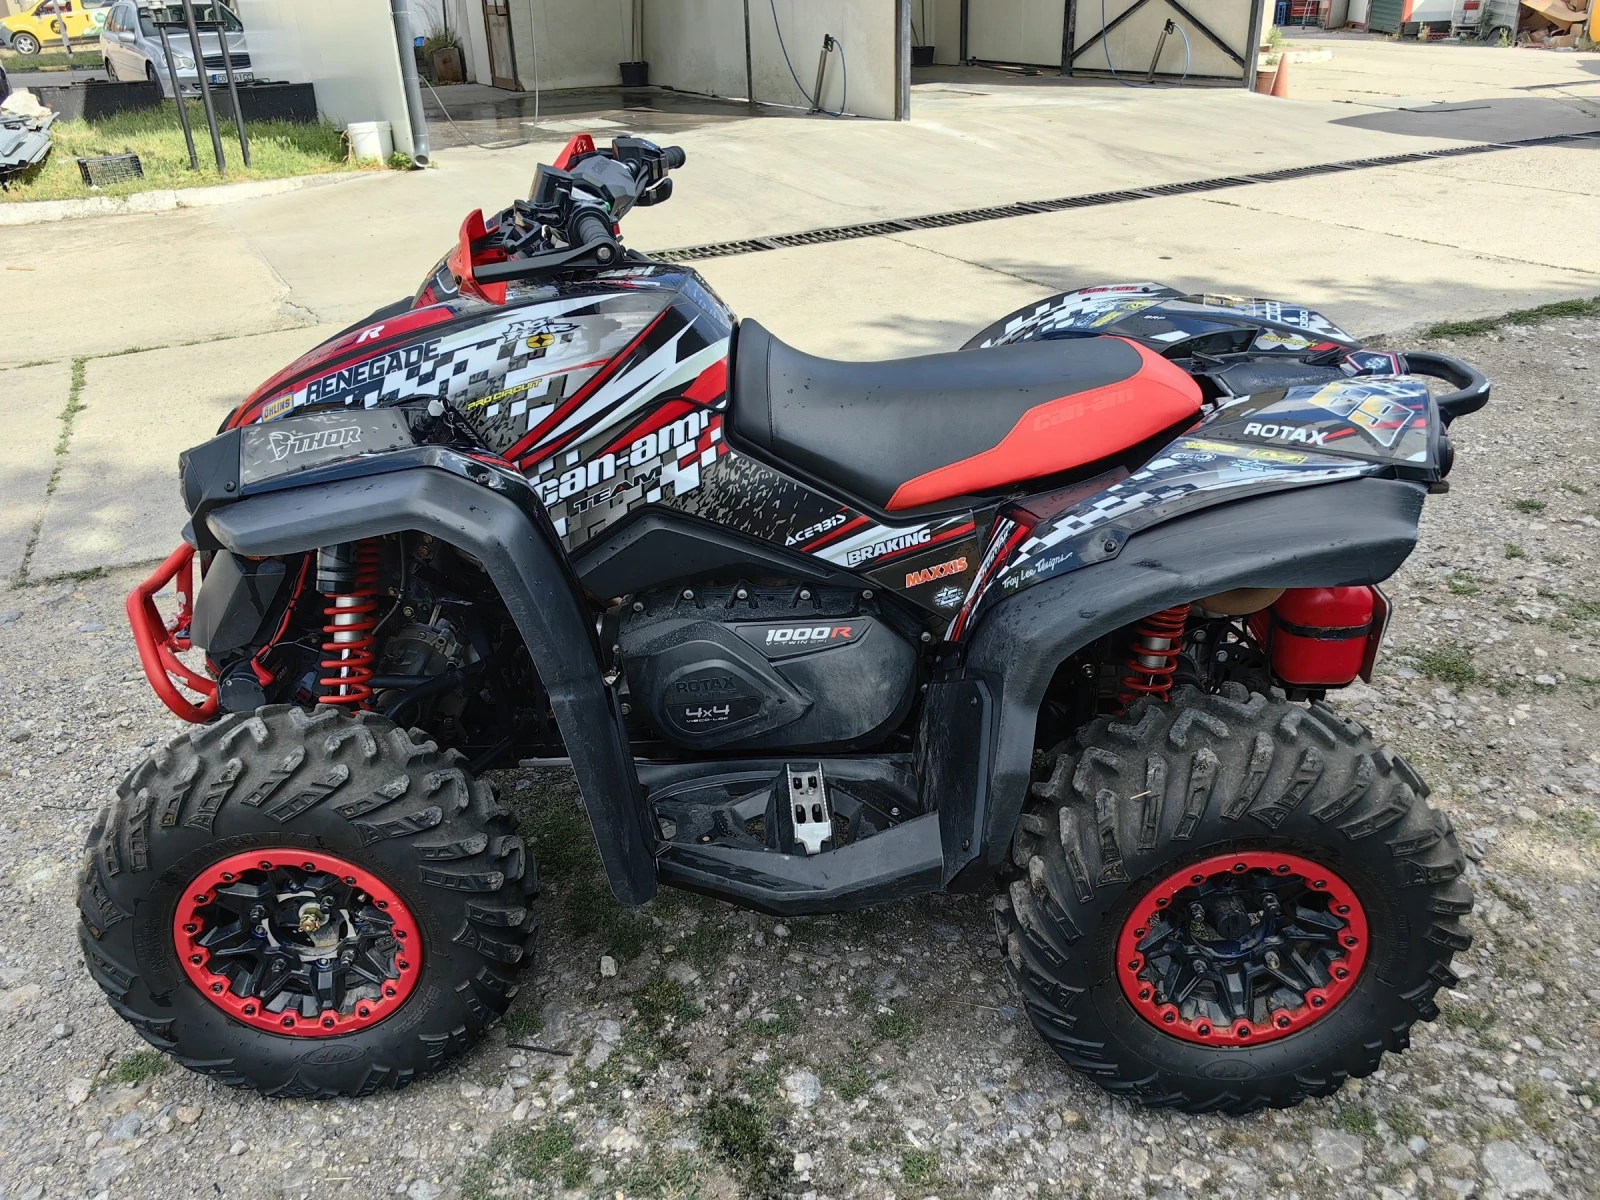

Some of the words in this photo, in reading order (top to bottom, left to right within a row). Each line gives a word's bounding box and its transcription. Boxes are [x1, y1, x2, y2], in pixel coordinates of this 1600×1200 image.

[304, 337, 443, 404] RENEGADE
[467, 395, 493, 411] PRO
[493, 379, 543, 402] CIRCUIT
[292, 426, 361, 454] THOR
[1243, 422, 1329, 446] ROTAX
[534, 411, 701, 507] can-am
[573, 464, 664, 513] TEAM
[847, 529, 931, 565] BRAKING
[905, 557, 968, 588] MAXXIS
[1002, 575, 1020, 589] Troy
[1020, 569, 1036, 581] Lee
[1035, 552, 1073, 574] Designs
[765, 626, 853, 642] 1000R
[674, 675, 736, 693] ROTAX
[685, 704, 730, 718] 4x4
